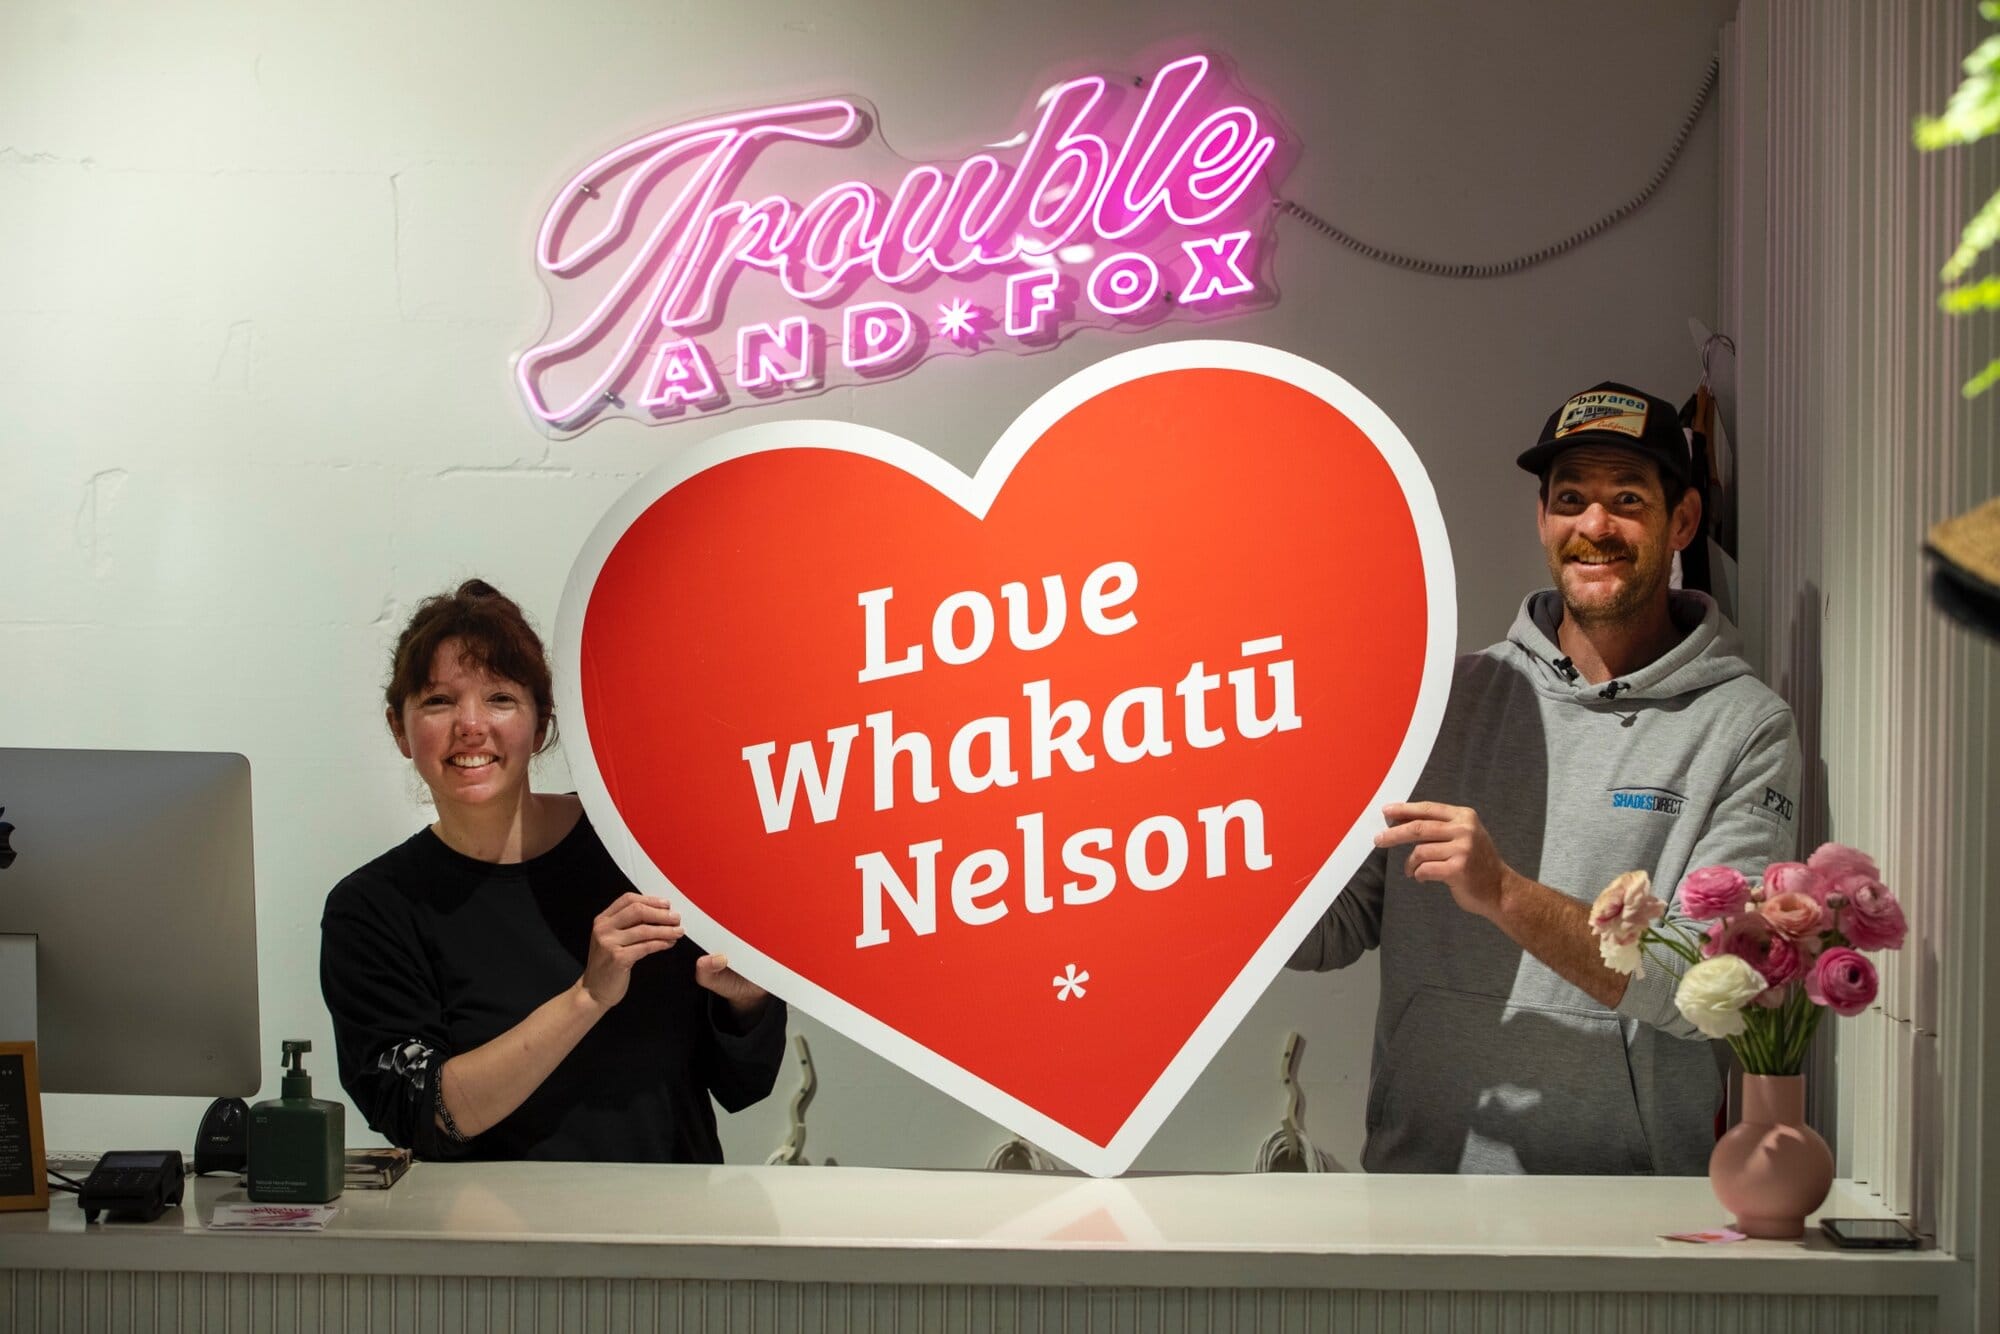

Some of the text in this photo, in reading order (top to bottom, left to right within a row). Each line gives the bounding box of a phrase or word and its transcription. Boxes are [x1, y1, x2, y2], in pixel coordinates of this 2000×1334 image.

[518, 54, 1277, 421] Trouble
[640, 231, 1254, 405] AND FOX
[1578, 394, 1607, 405] bay
[1608, 395, 1645, 410] area
[857, 561, 1138, 683] Love
[742, 635, 1302, 834] Whakatū
[855, 798, 1272, 949] Nelson
